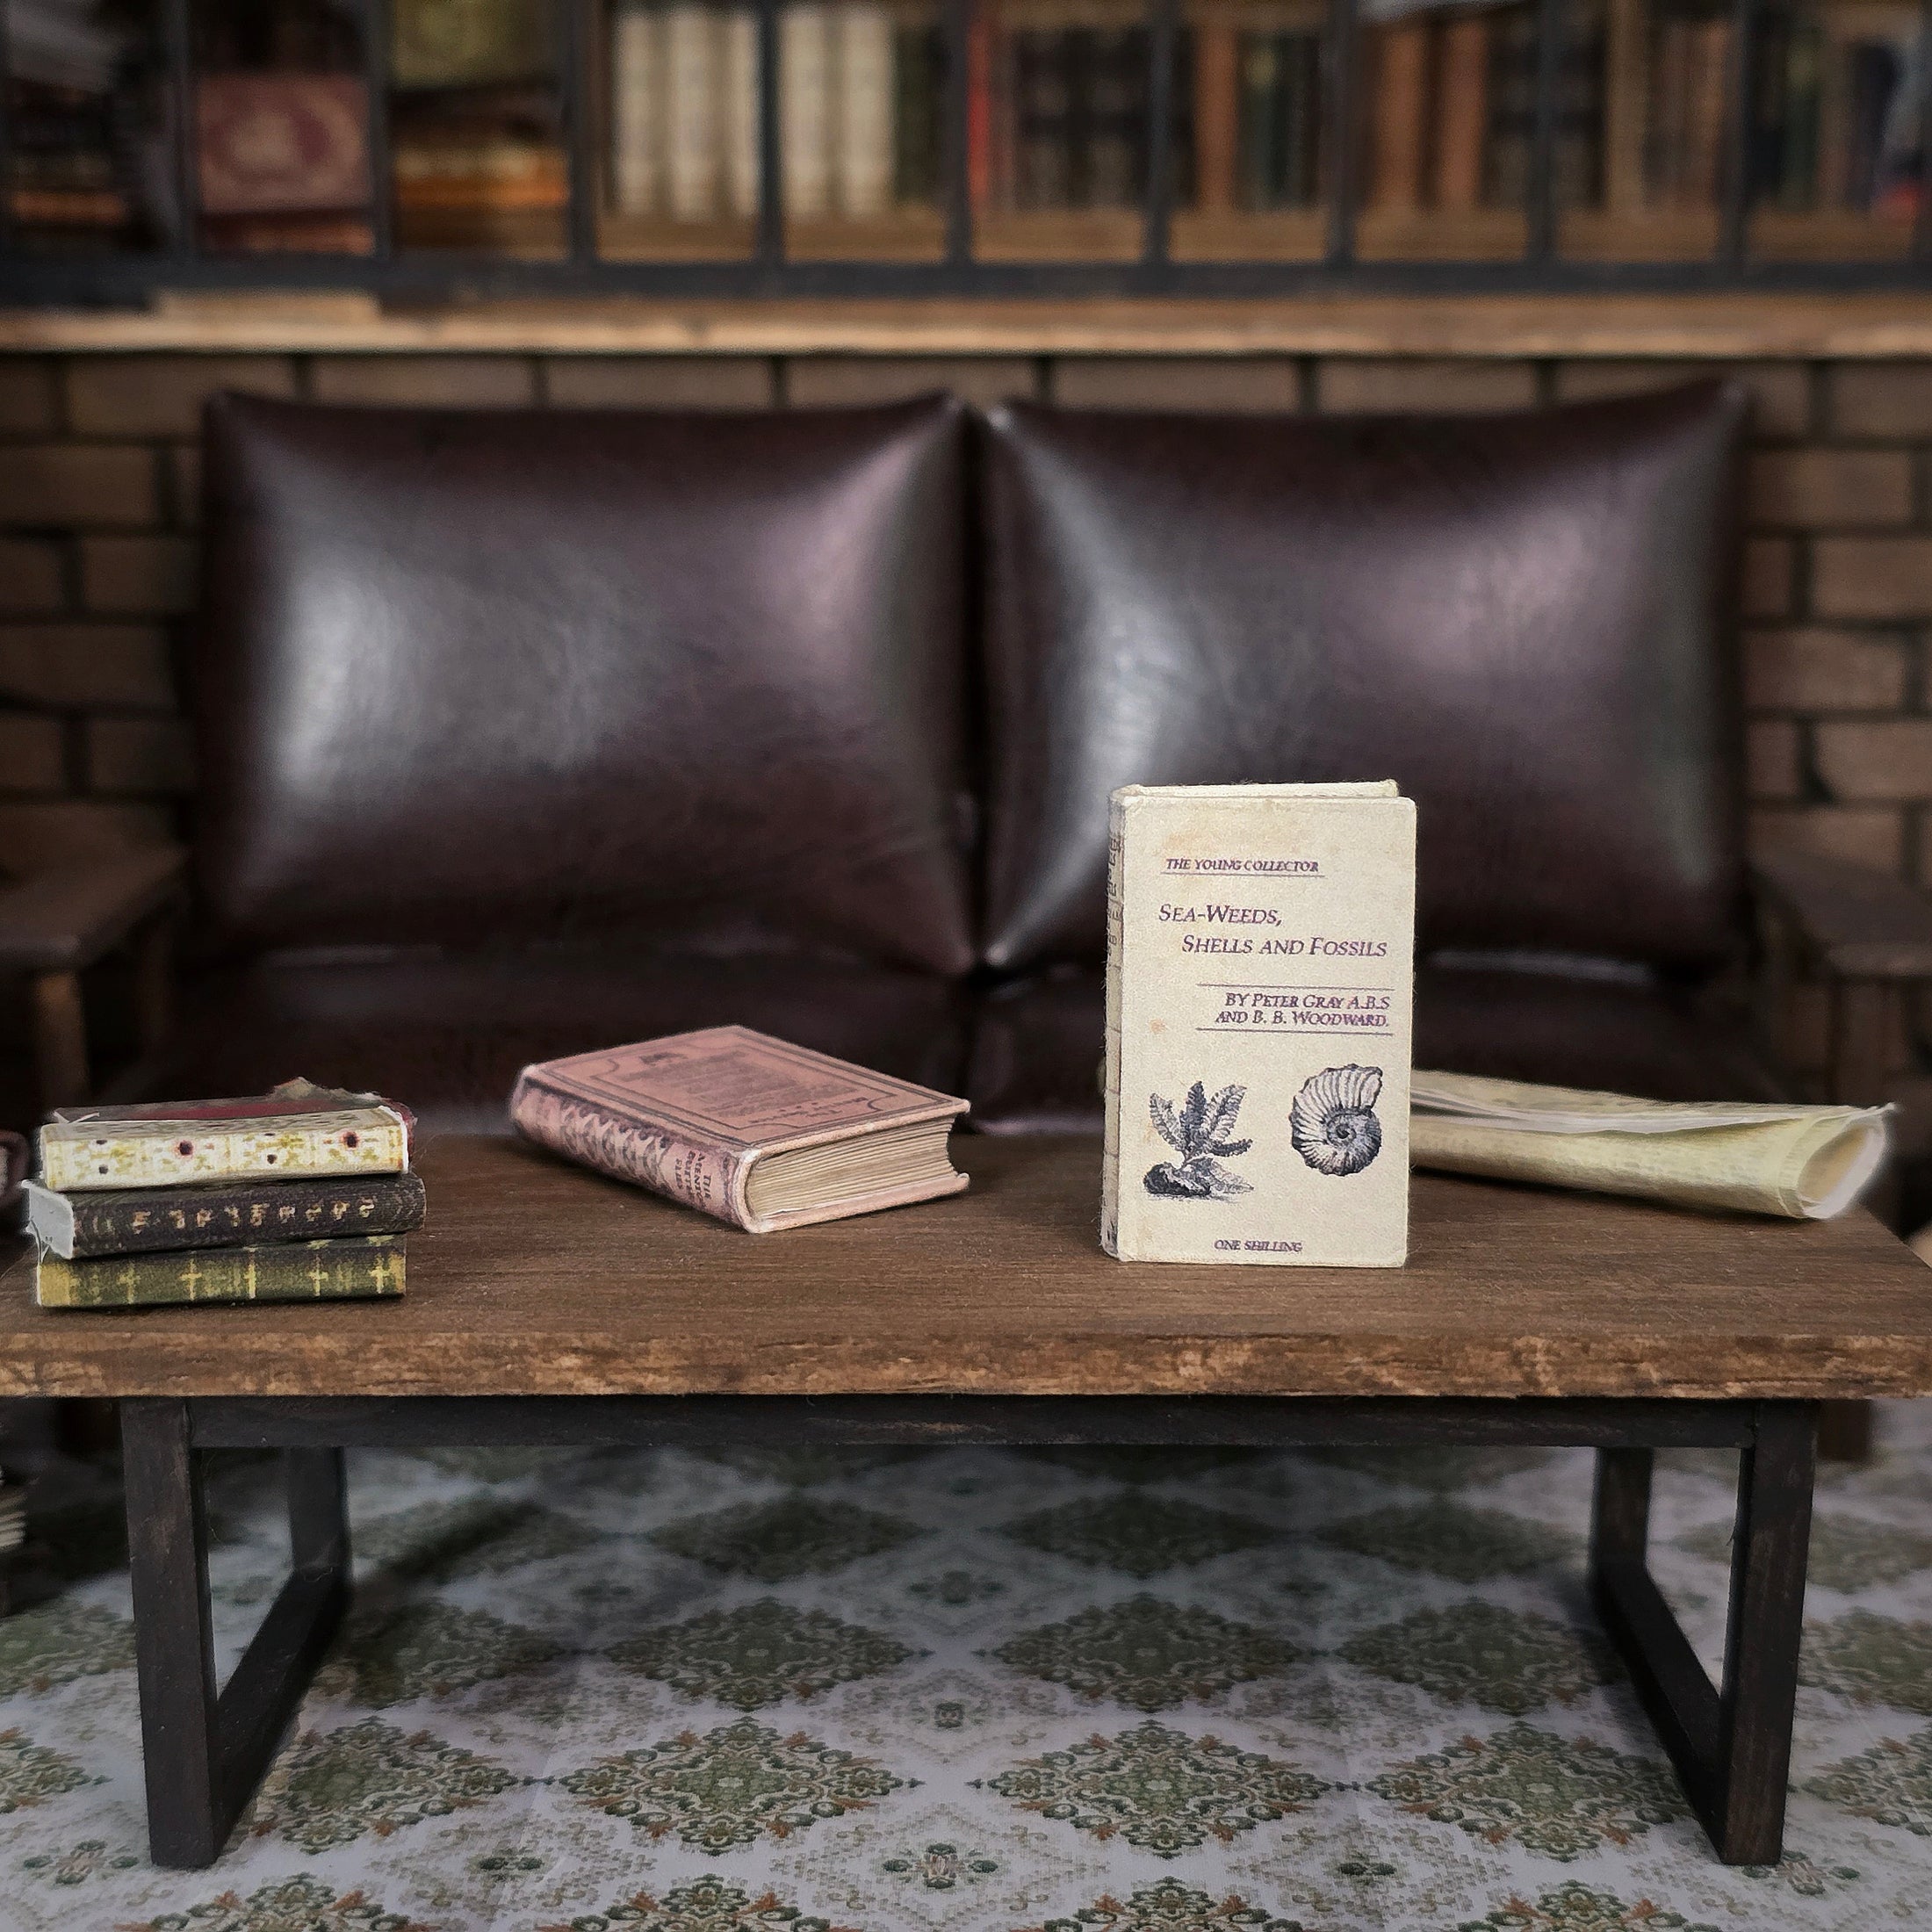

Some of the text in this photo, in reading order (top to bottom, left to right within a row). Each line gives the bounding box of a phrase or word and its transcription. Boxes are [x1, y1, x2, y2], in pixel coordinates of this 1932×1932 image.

[1165, 857, 1319, 873] THE YOUNG COLLECTOR
[1157, 903, 1283, 927] SEA-WEEDS,
[1181, 934, 1388, 957] SHELLS AND FOSSILS
[1224, 992, 1250, 1007] BY
[1251, 992, 1300, 1009] PETER
[1302, 994, 1345, 1010] GRAY
[1215, 1009, 1390, 1027] AND B. B. WOODWARD.
[1214, 1239, 1303, 1252] ONE SHILLING
